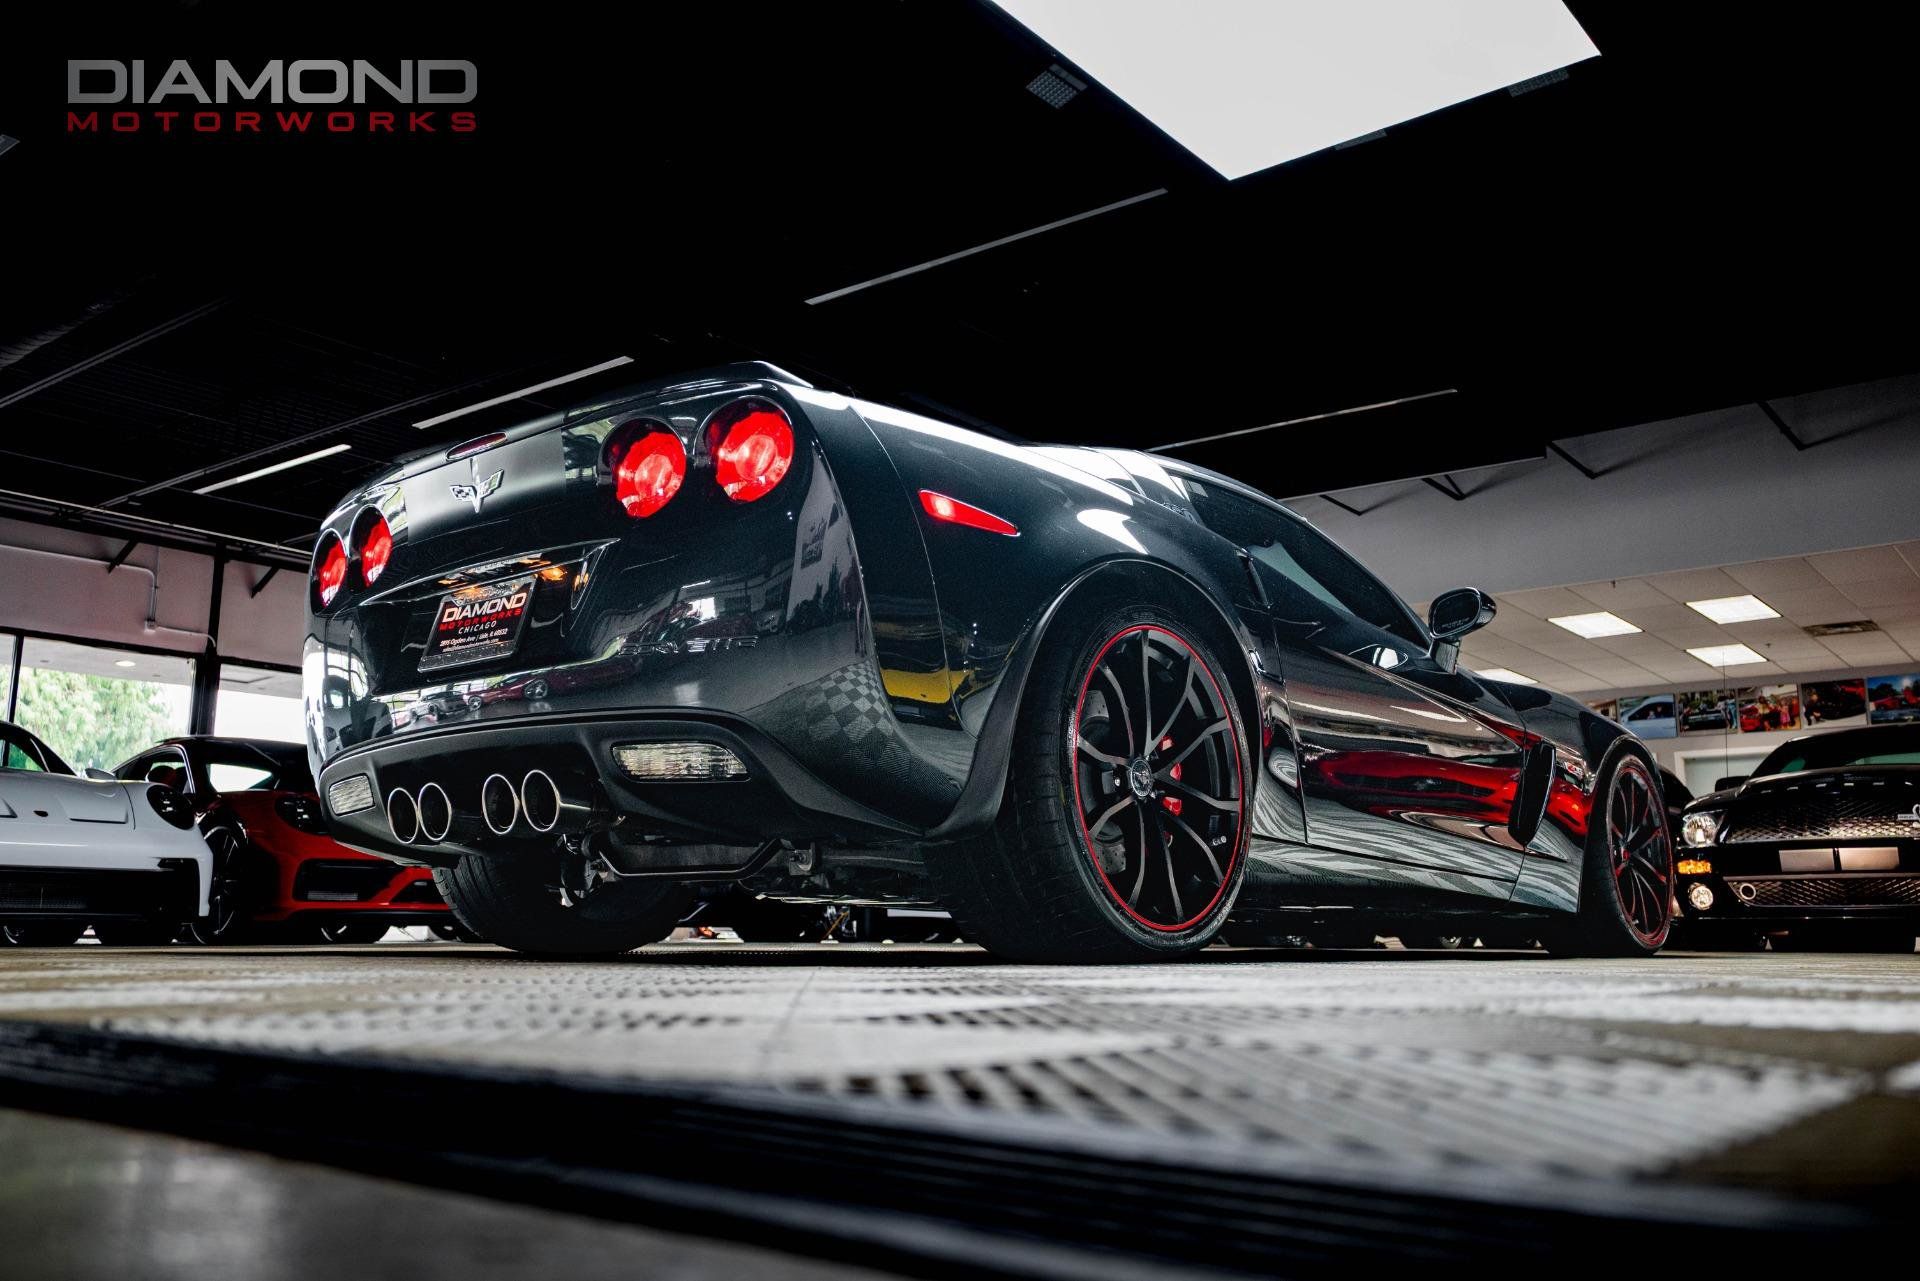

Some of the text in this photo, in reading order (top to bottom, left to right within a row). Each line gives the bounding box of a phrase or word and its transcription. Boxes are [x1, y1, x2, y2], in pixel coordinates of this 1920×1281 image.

[442, 592, 528, 623] DIAMOND
[438, 608, 523, 631] MOTORWORKS
[458, 620, 497, 635] CHICAGO
